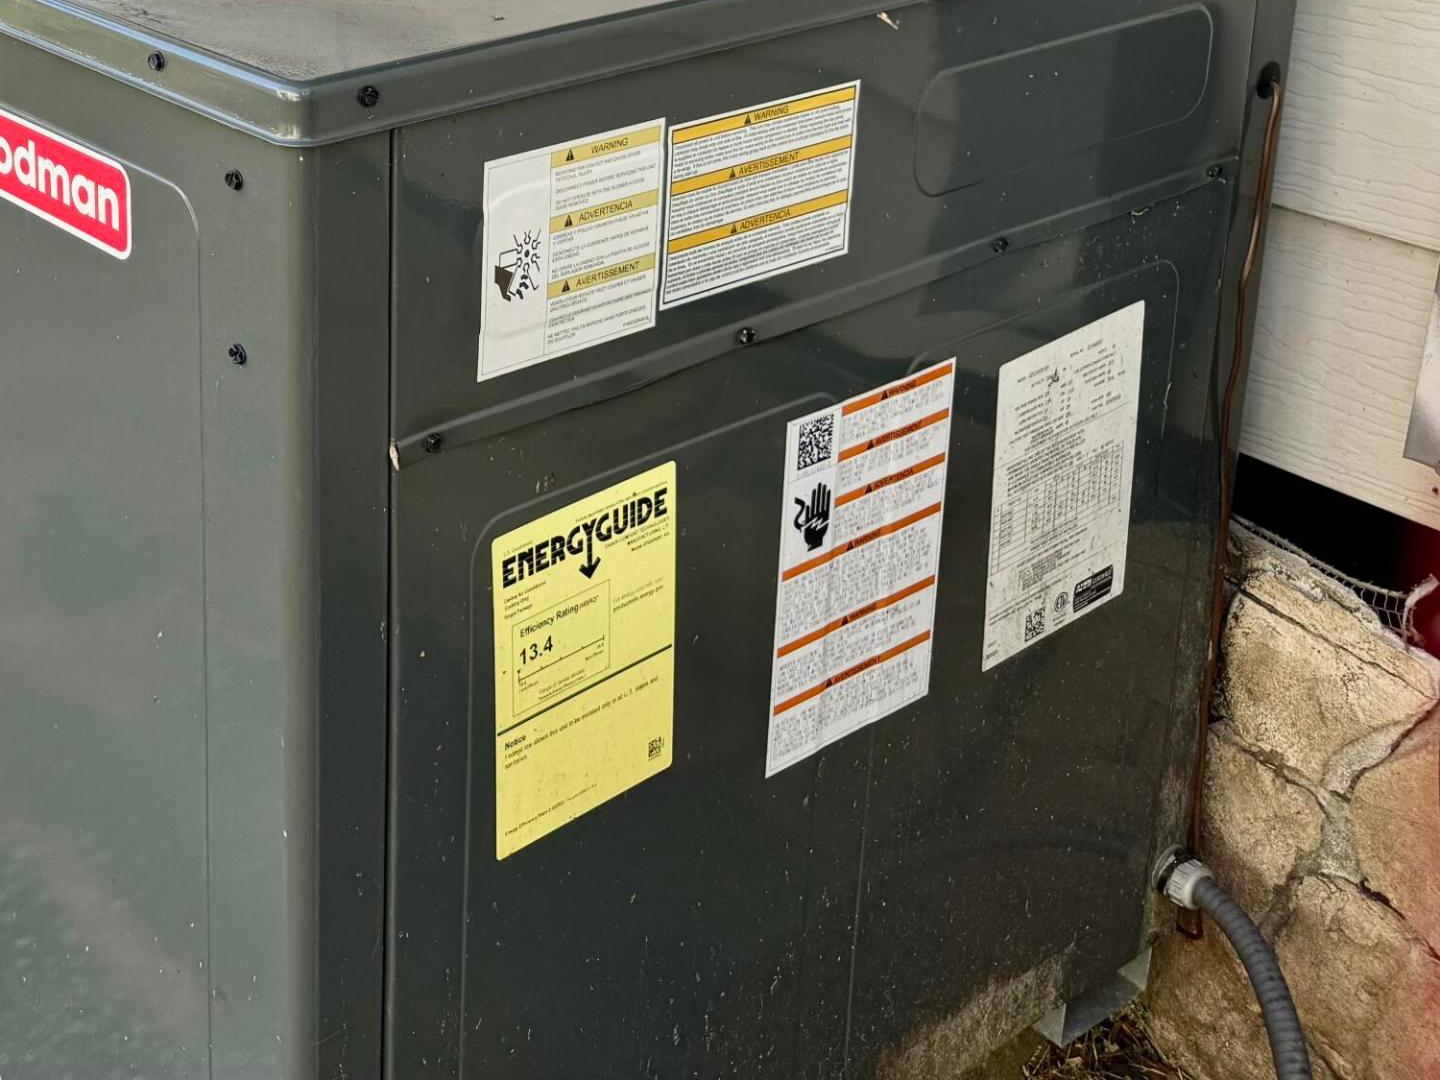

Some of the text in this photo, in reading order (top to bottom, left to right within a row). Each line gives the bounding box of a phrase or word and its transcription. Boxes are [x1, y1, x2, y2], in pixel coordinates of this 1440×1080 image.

[753, 105, 789, 122] WARNING
[591, 138, 628, 154] WARNING
[738, 151, 800, 176] AVERTISSEMENT
[578, 200, 633, 222] ADVERTENCIA
[740, 209, 791, 230] ADVERTENCIA
[576, 261, 640, 287] AVERTISSEMENT
[502, 487, 667, 588] ENERGYGUIDE
[520, 615, 555, 638] Efficiency
[556, 603, 579, 621] Rating
[520, 634, 553, 665] 13.4
[505, 734, 527, 750] Notice
